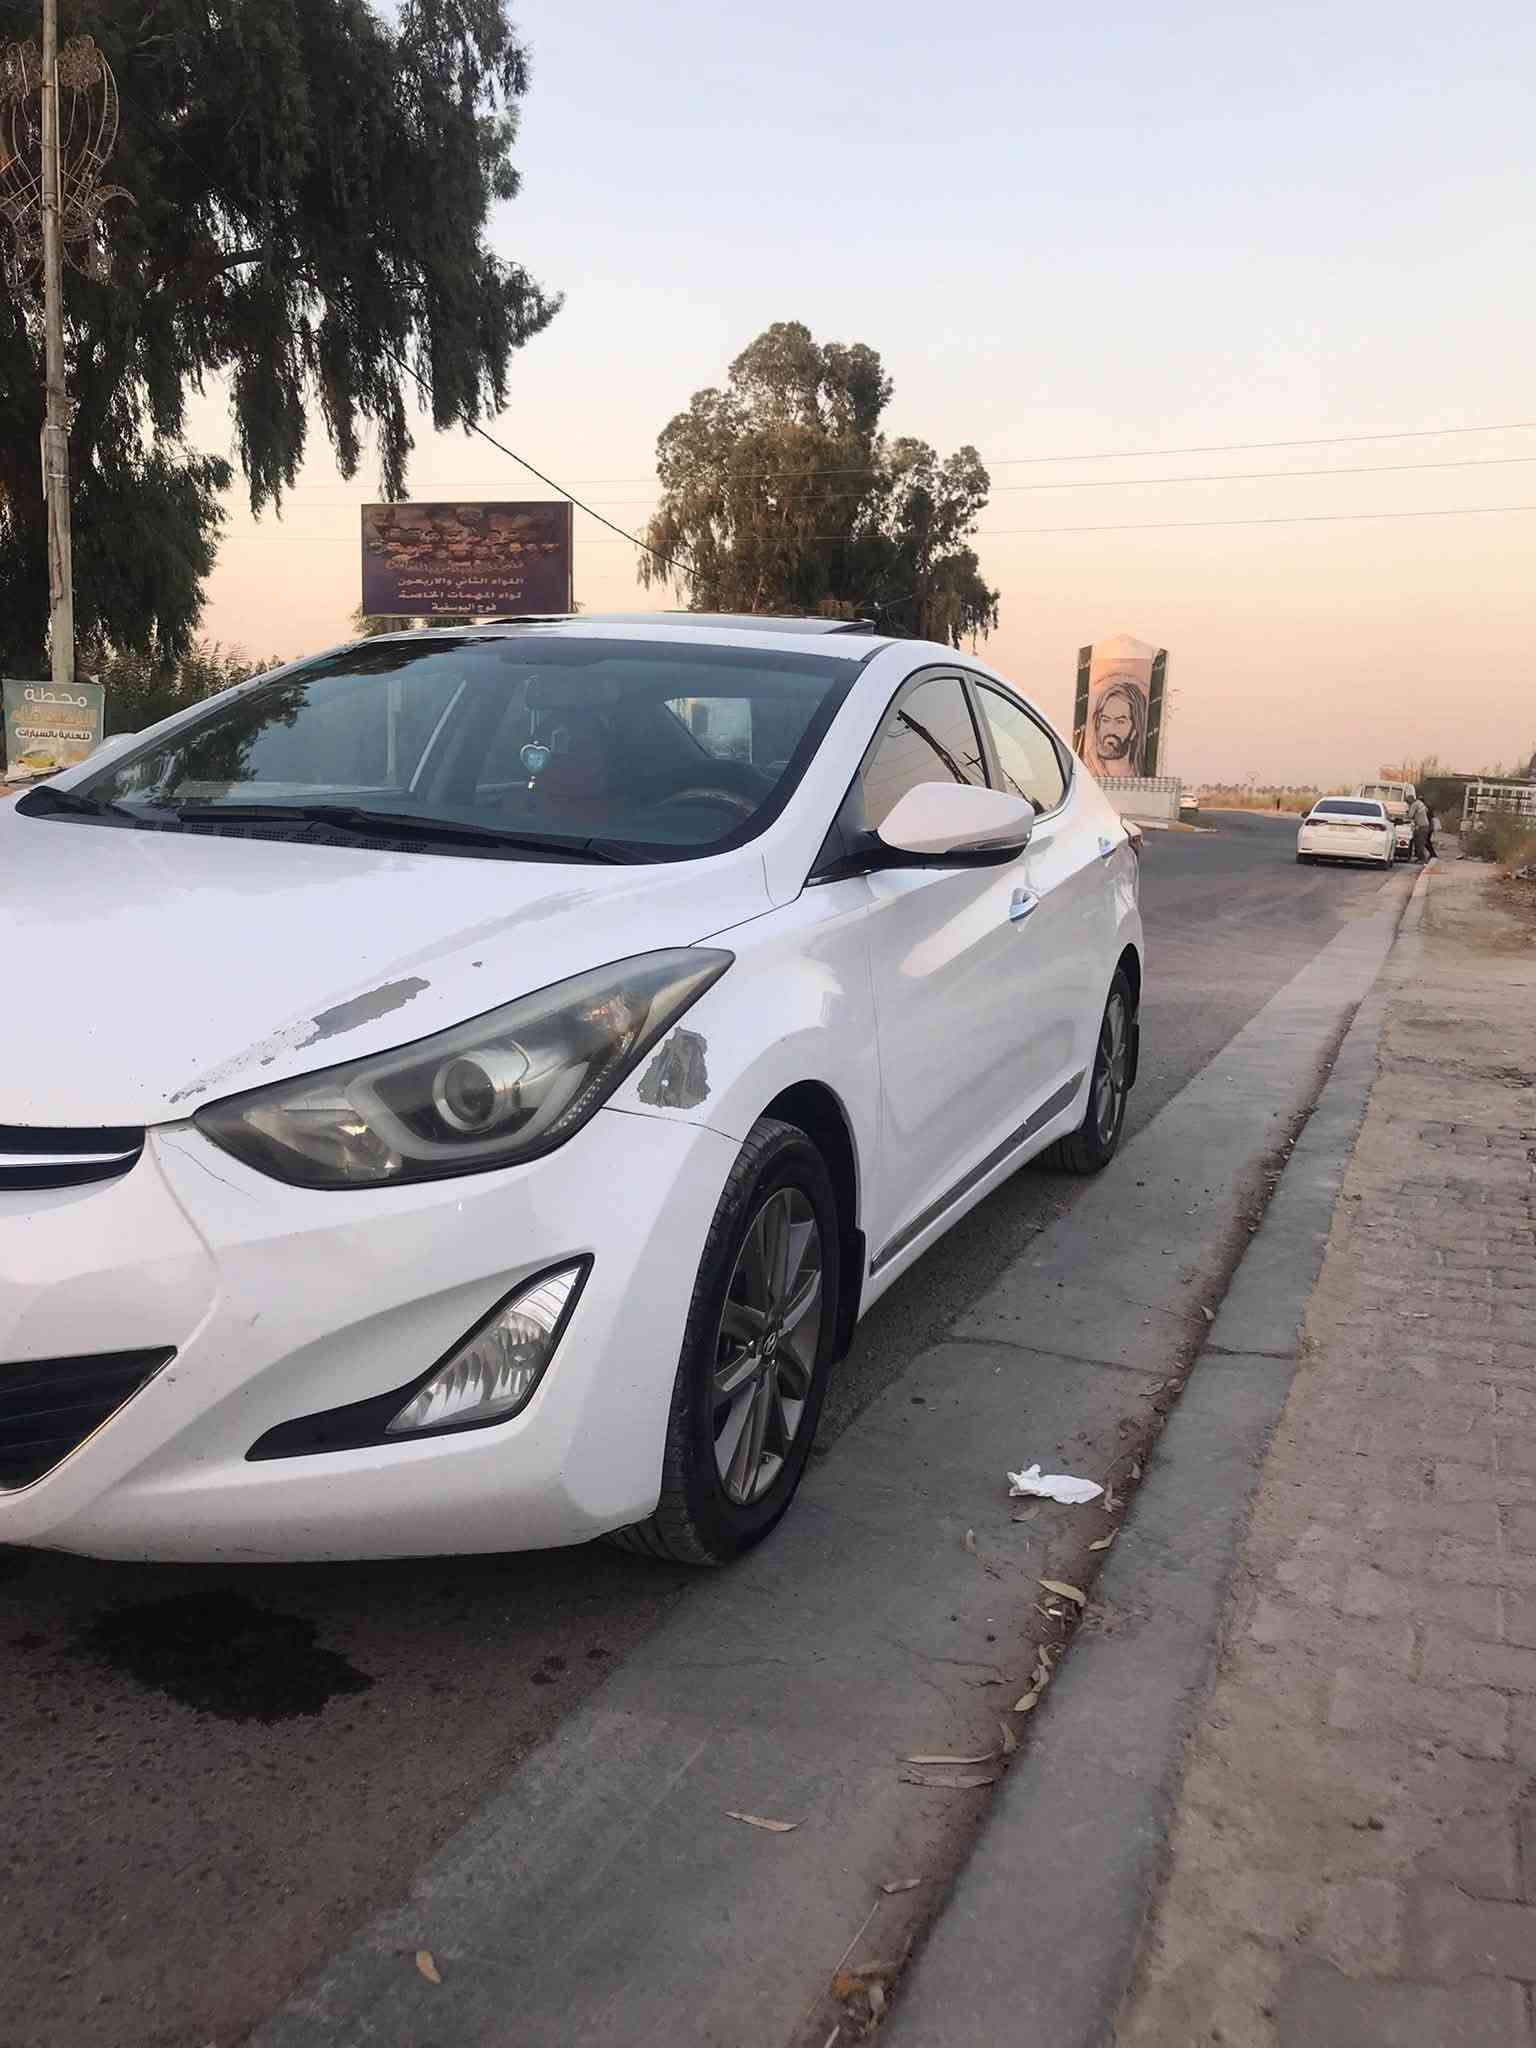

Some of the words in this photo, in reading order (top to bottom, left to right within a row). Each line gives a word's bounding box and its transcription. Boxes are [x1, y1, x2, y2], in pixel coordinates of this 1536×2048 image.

[456, 577, 488, 588] الثاني
[398, 589, 443, 600] الخاصة
[24, 683, 88, 707] محطة
[18, 728, 57, 738] بالسيارات
